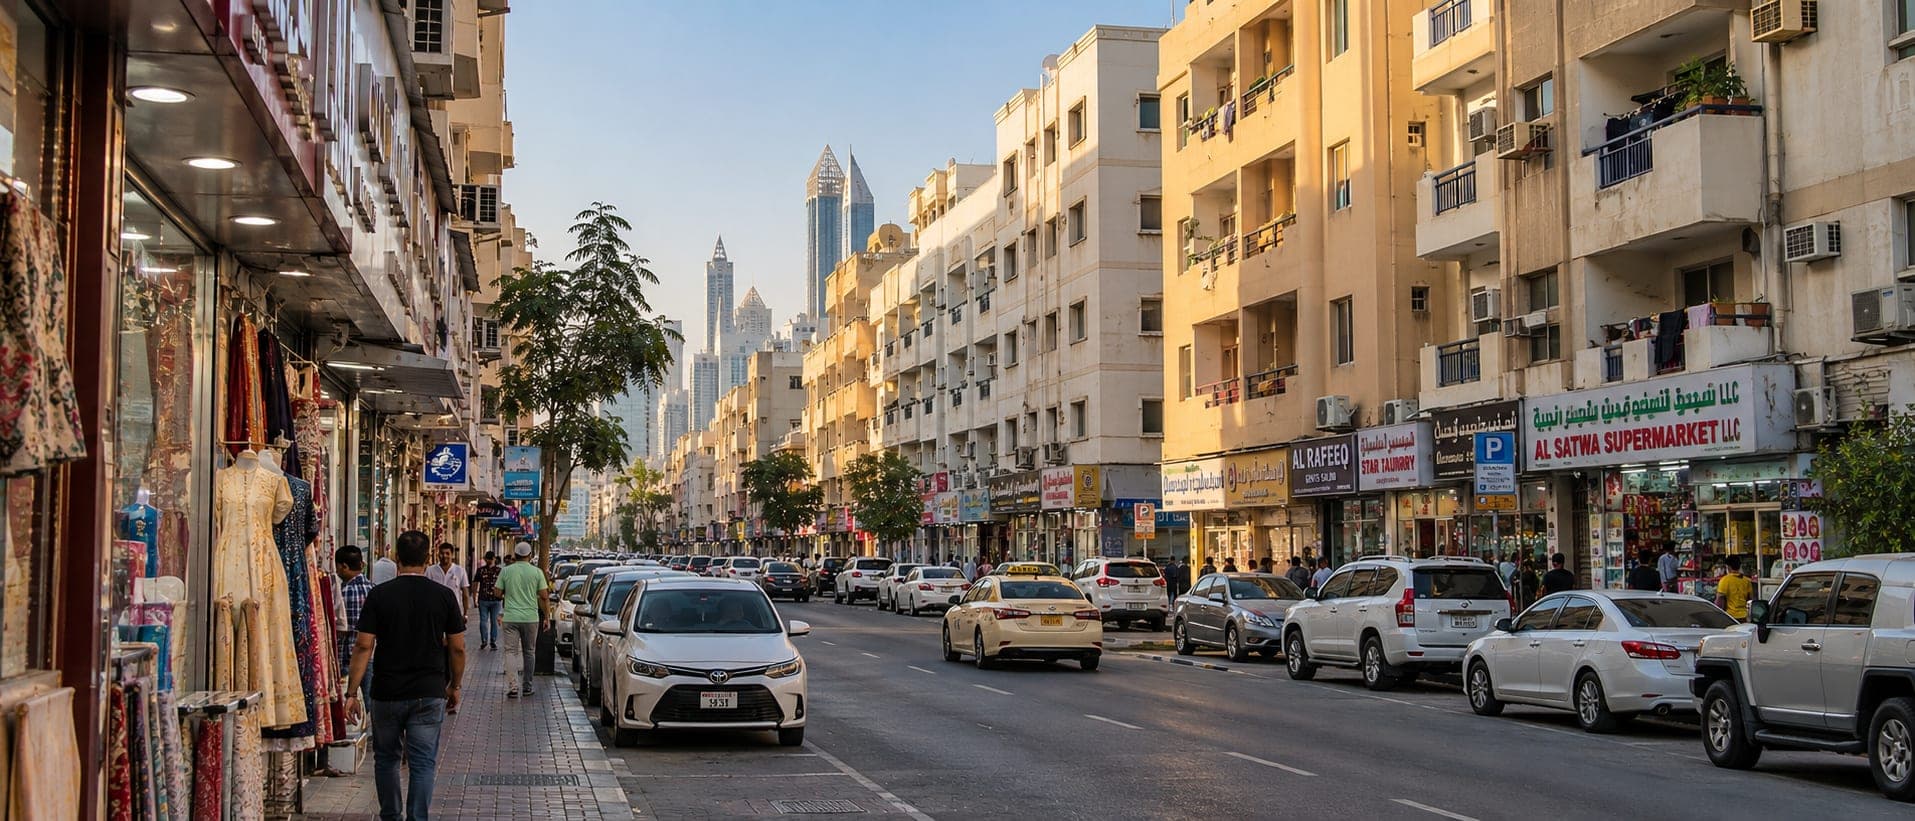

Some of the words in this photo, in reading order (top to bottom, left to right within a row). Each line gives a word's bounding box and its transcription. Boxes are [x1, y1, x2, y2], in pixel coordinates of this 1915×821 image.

[1719, 381, 1740, 405] LLC
[1485, 437, 1503, 460] P
[1534, 439, 1552, 461] AL
[1554, 432, 1601, 459] SATWA
[1604, 420, 1719, 454] SUPERMARKET
[1722, 417, 1741, 443] LLC
[1292, 448, 1305, 470] AL
[1307, 443, 1350, 471] RAFEEQ
